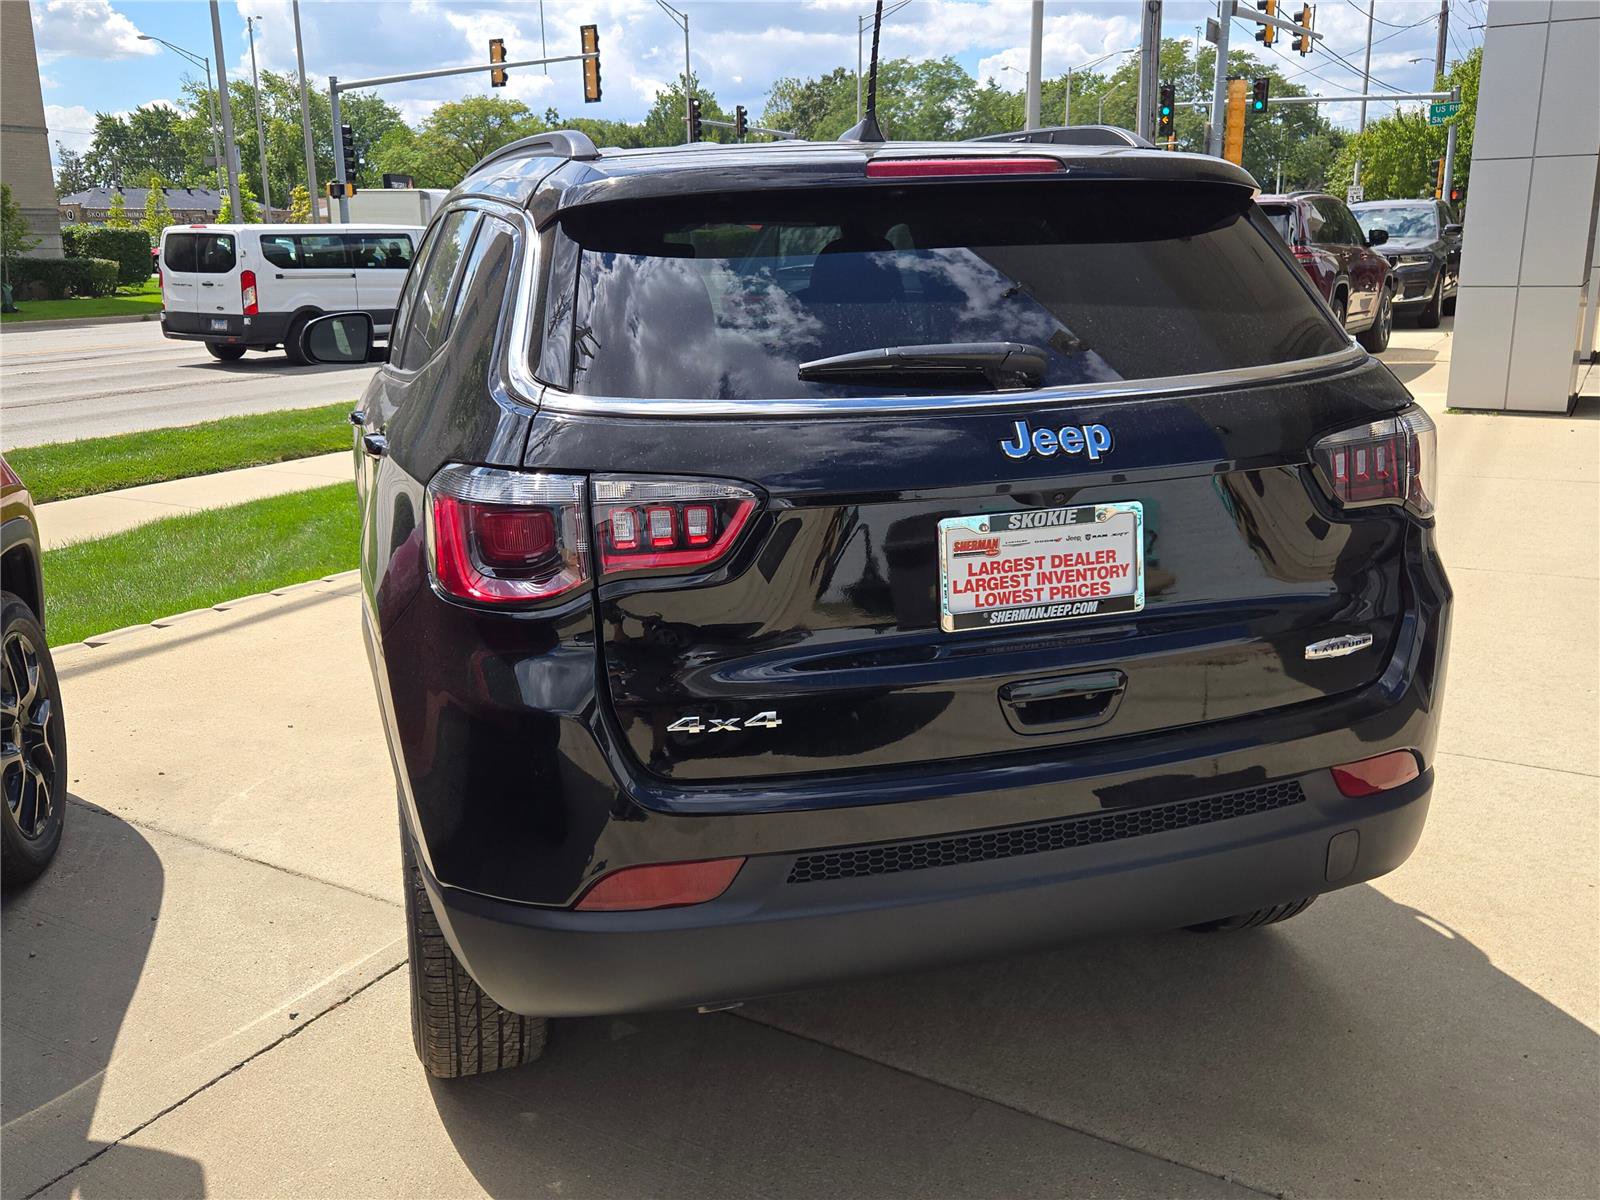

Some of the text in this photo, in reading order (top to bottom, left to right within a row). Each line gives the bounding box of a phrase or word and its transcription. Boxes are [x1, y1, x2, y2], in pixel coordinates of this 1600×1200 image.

[1435, 105, 1447, 113] US
[1001, 421, 1112, 459] Jeep
[1008, 509, 1078, 530] SKOKIE
[953, 538, 999, 553] SHERMAN
[968, 549, 1117, 577] LARGEST DEALER
[952, 563, 1130, 594] LARGEST INVENTORY
[975, 581, 1111, 608] LOWEST PRICES
[989, 601, 1099, 624] SHERMANJEEP.COM
